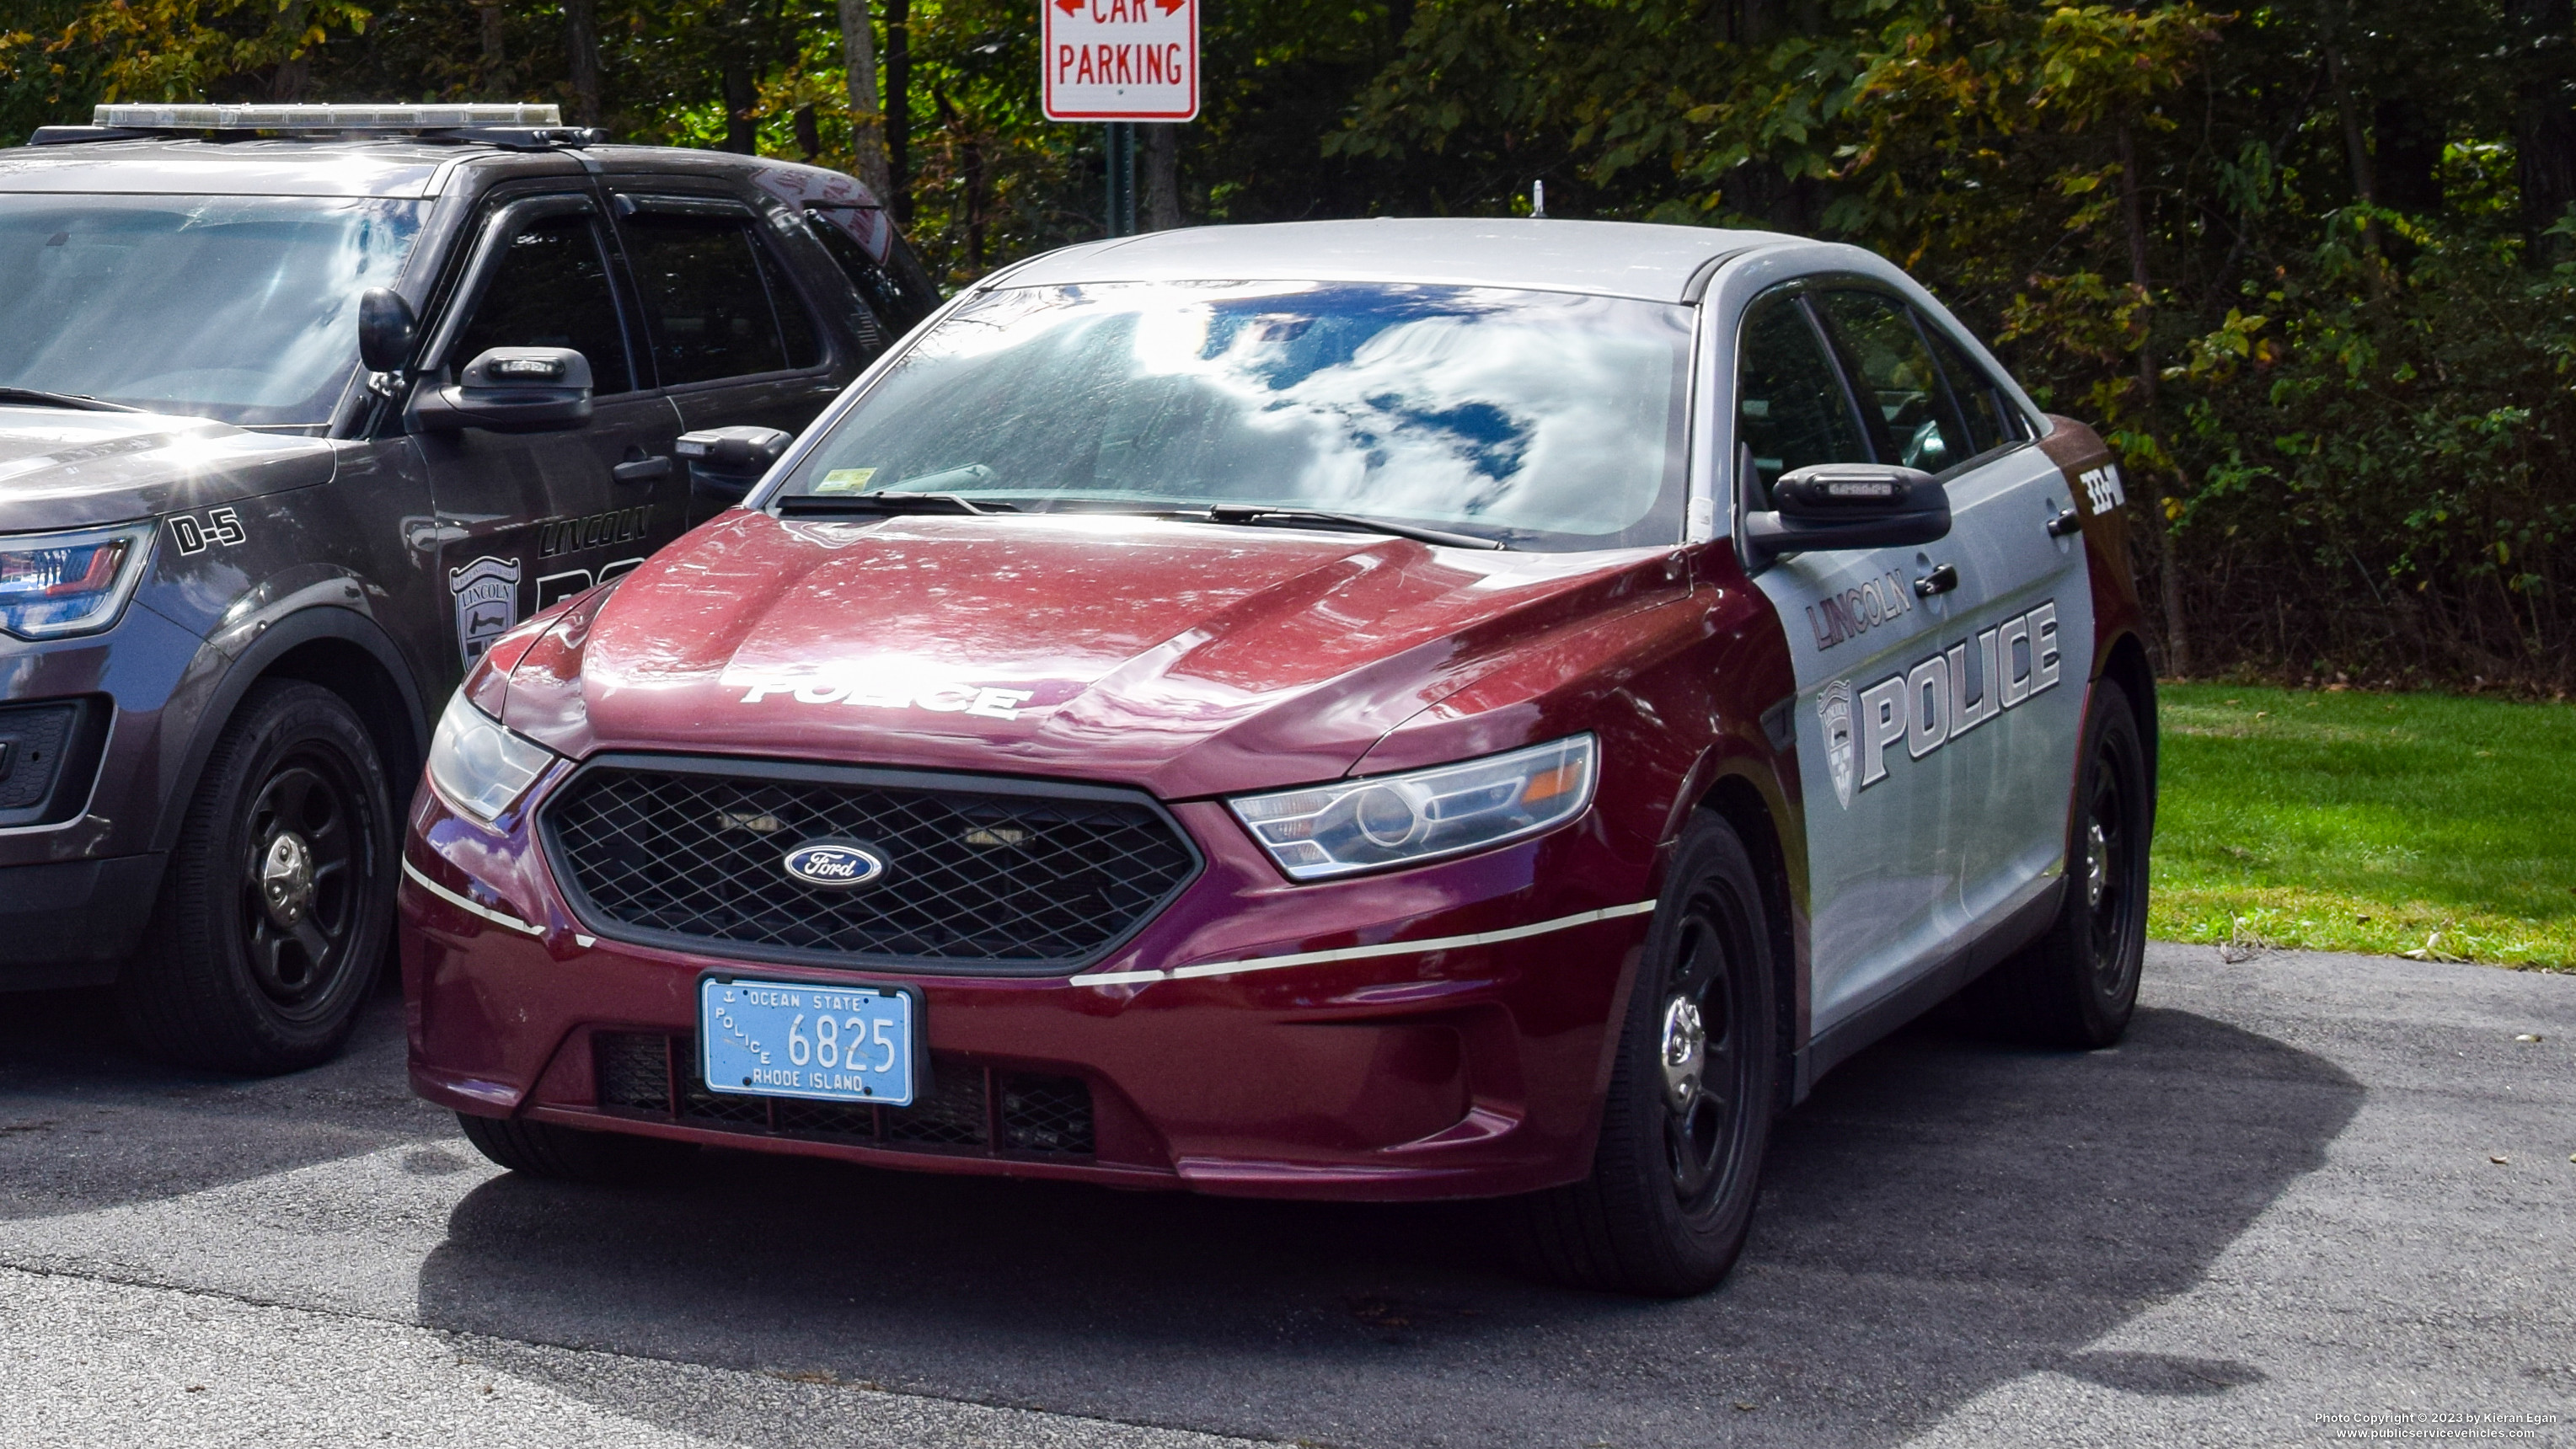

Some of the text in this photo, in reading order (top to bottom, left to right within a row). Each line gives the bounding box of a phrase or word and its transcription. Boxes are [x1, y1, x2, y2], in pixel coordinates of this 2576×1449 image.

[1092, 0, 1148, 24] CAR
[1059, 43, 1181, 85] PARKING
[169, 507, 246, 556] D-5
[538, 505, 654, 559] LINCOLN
[462, 583, 511, 607] LINCOLN
[1806, 568, 1911, 652] LINCOLN
[1856, 597, 2061, 792] POLICE
[805, 852, 857, 876] Ford
[750, 991, 861, 1012] OCEAN STATE
[715, 1008, 771, 1065] POLICE
[789, 1013, 895, 1073] 6825
[752, 1068, 862, 1092] RHODE ISLAND
